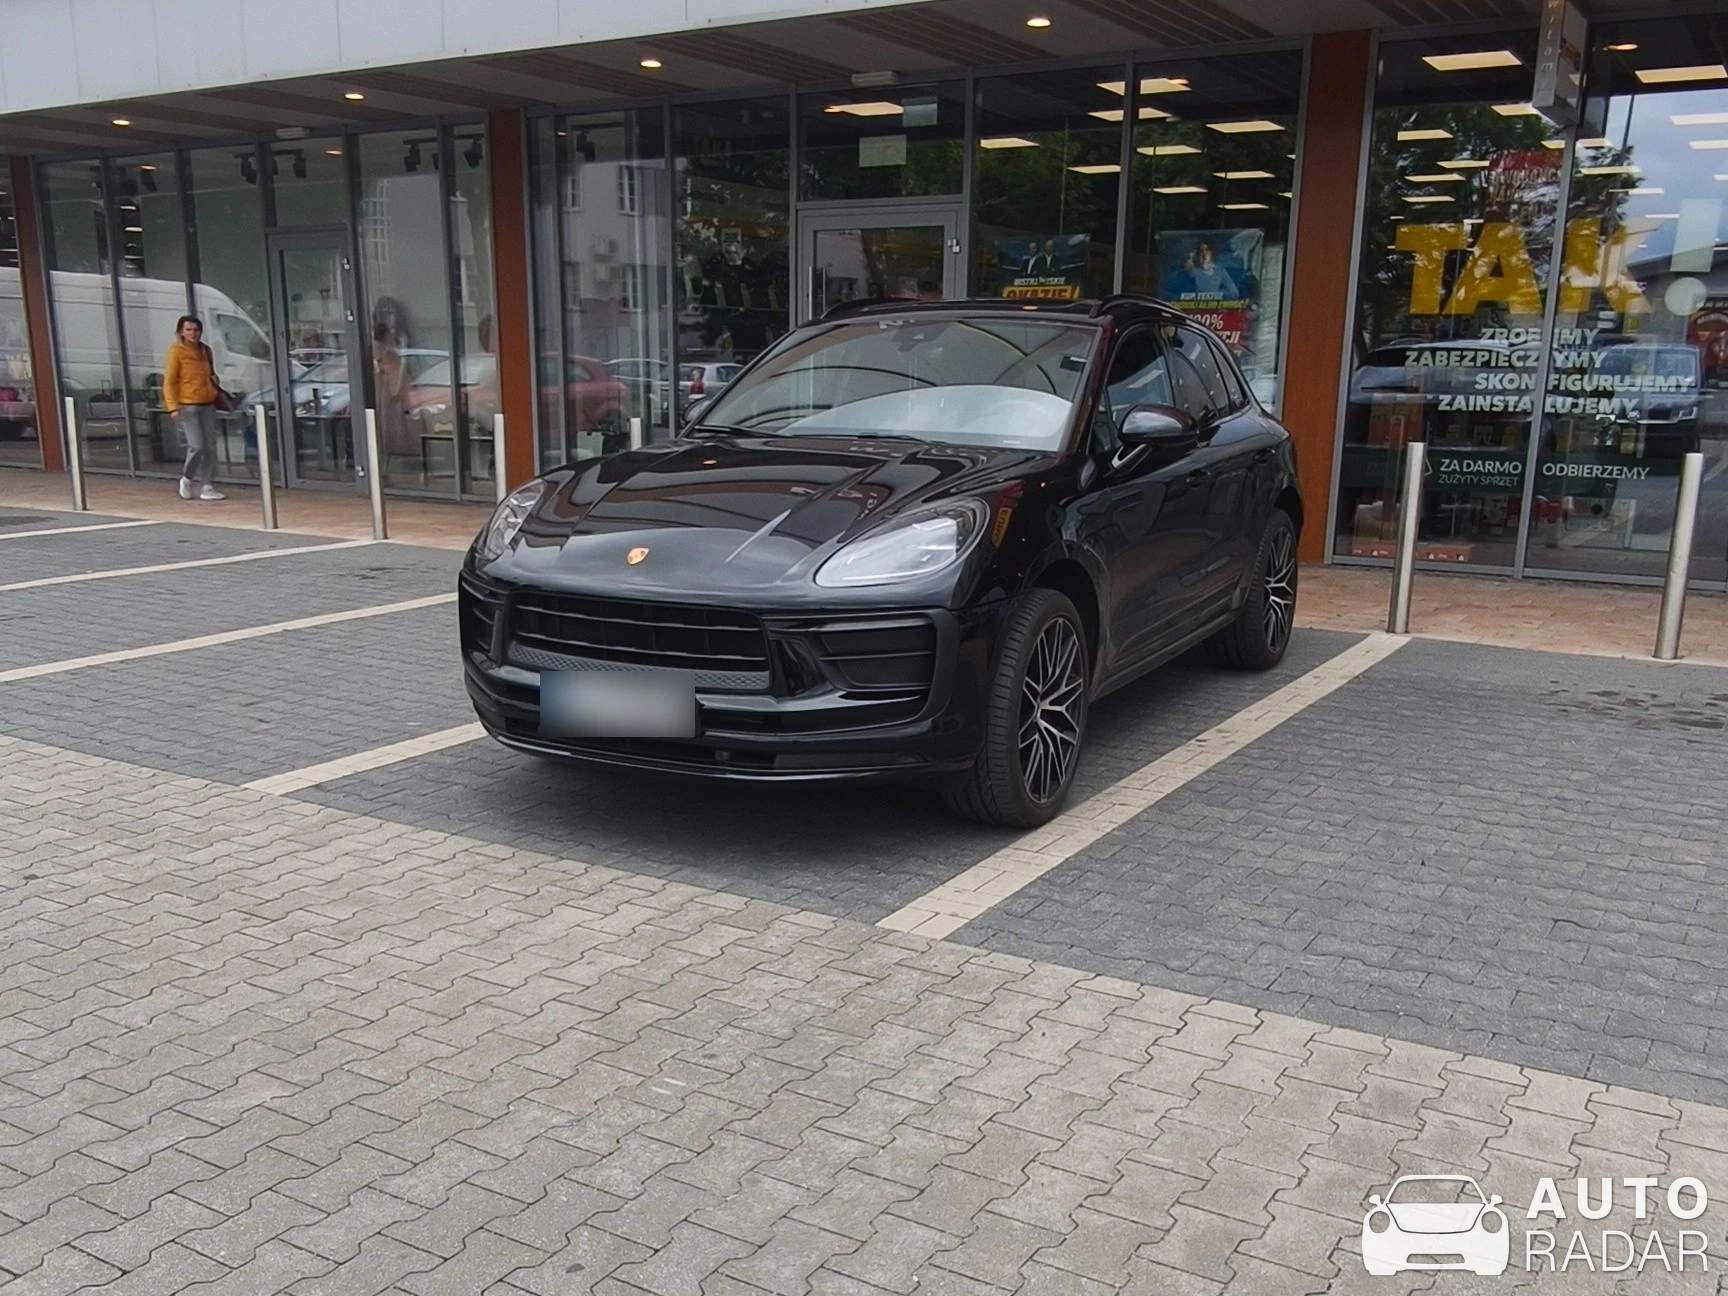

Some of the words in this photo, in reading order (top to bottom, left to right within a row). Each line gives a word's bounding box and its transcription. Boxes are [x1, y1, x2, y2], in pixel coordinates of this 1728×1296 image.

[1480, 327, 1600, 345] ZROBIMY
[1404, 350, 1608, 368] ZABEZPIECZYMY
[1474, 372, 1692, 392] SKONFIGURUJEMY
[1437, 395, 1639, 414] ZAINSTALUJEMY
[1439, 459, 1460, 472] ZA
[1462, 459, 1522, 474] DARMO
[1542, 462, 1650, 480] ODBIERZEMY
[1480, 475, 1519, 487] SPRZĘT
